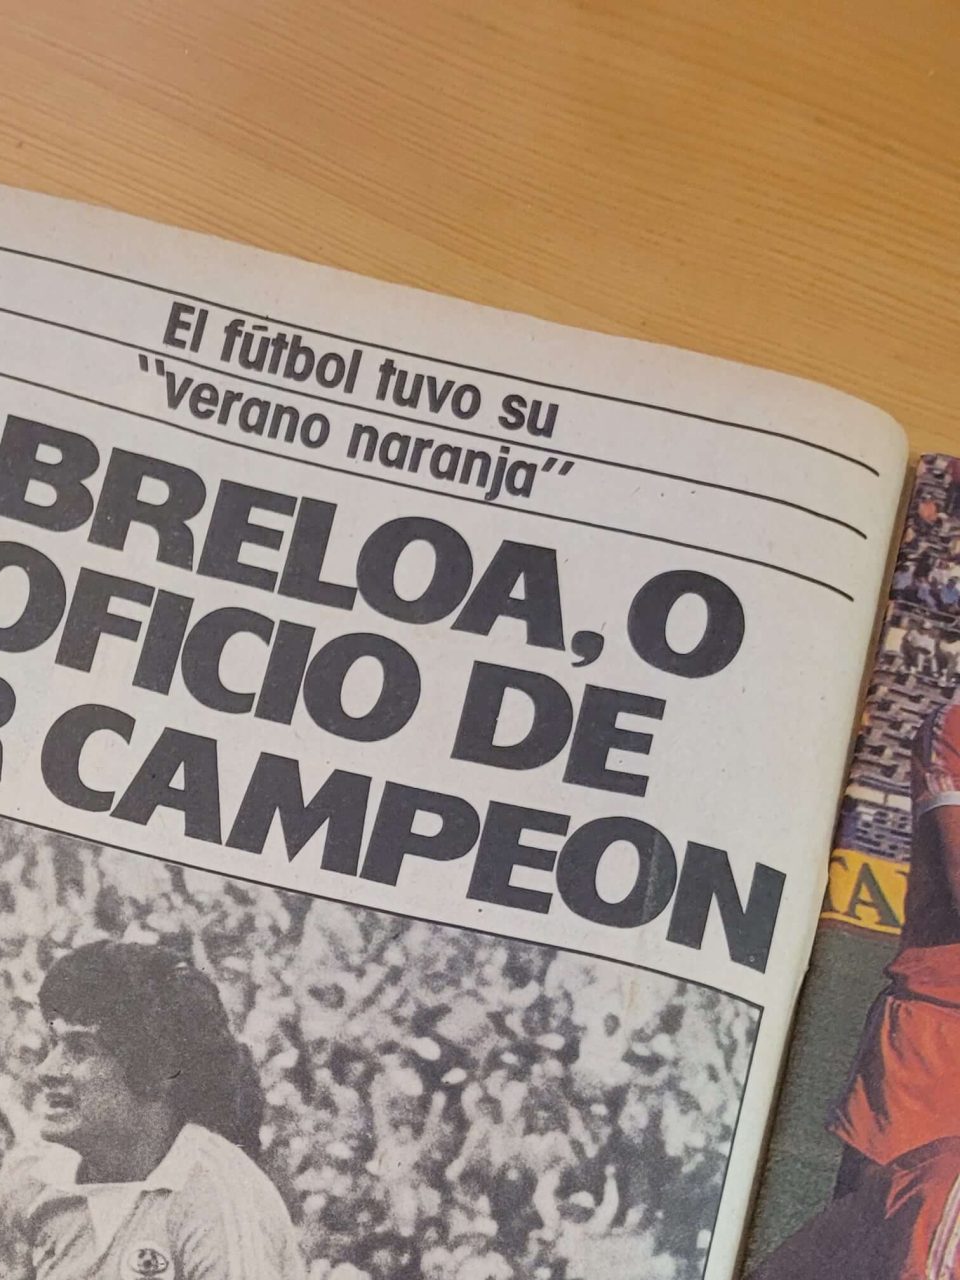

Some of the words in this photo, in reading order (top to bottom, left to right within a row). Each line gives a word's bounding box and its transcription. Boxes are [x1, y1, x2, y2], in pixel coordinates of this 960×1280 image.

[139, 353, 330, 448] "verano
[347, 422, 575, 500] naranja"
[162, 301, 208, 353] El
[220, 319, 363, 395] fútbol
[376, 359, 481, 420] tuvo
[498, 394, 559, 438] su
[627, 570, 746, 679] O
[451, 661, 666, 797] DE
[39, 703, 787, 974] CAMPEON
